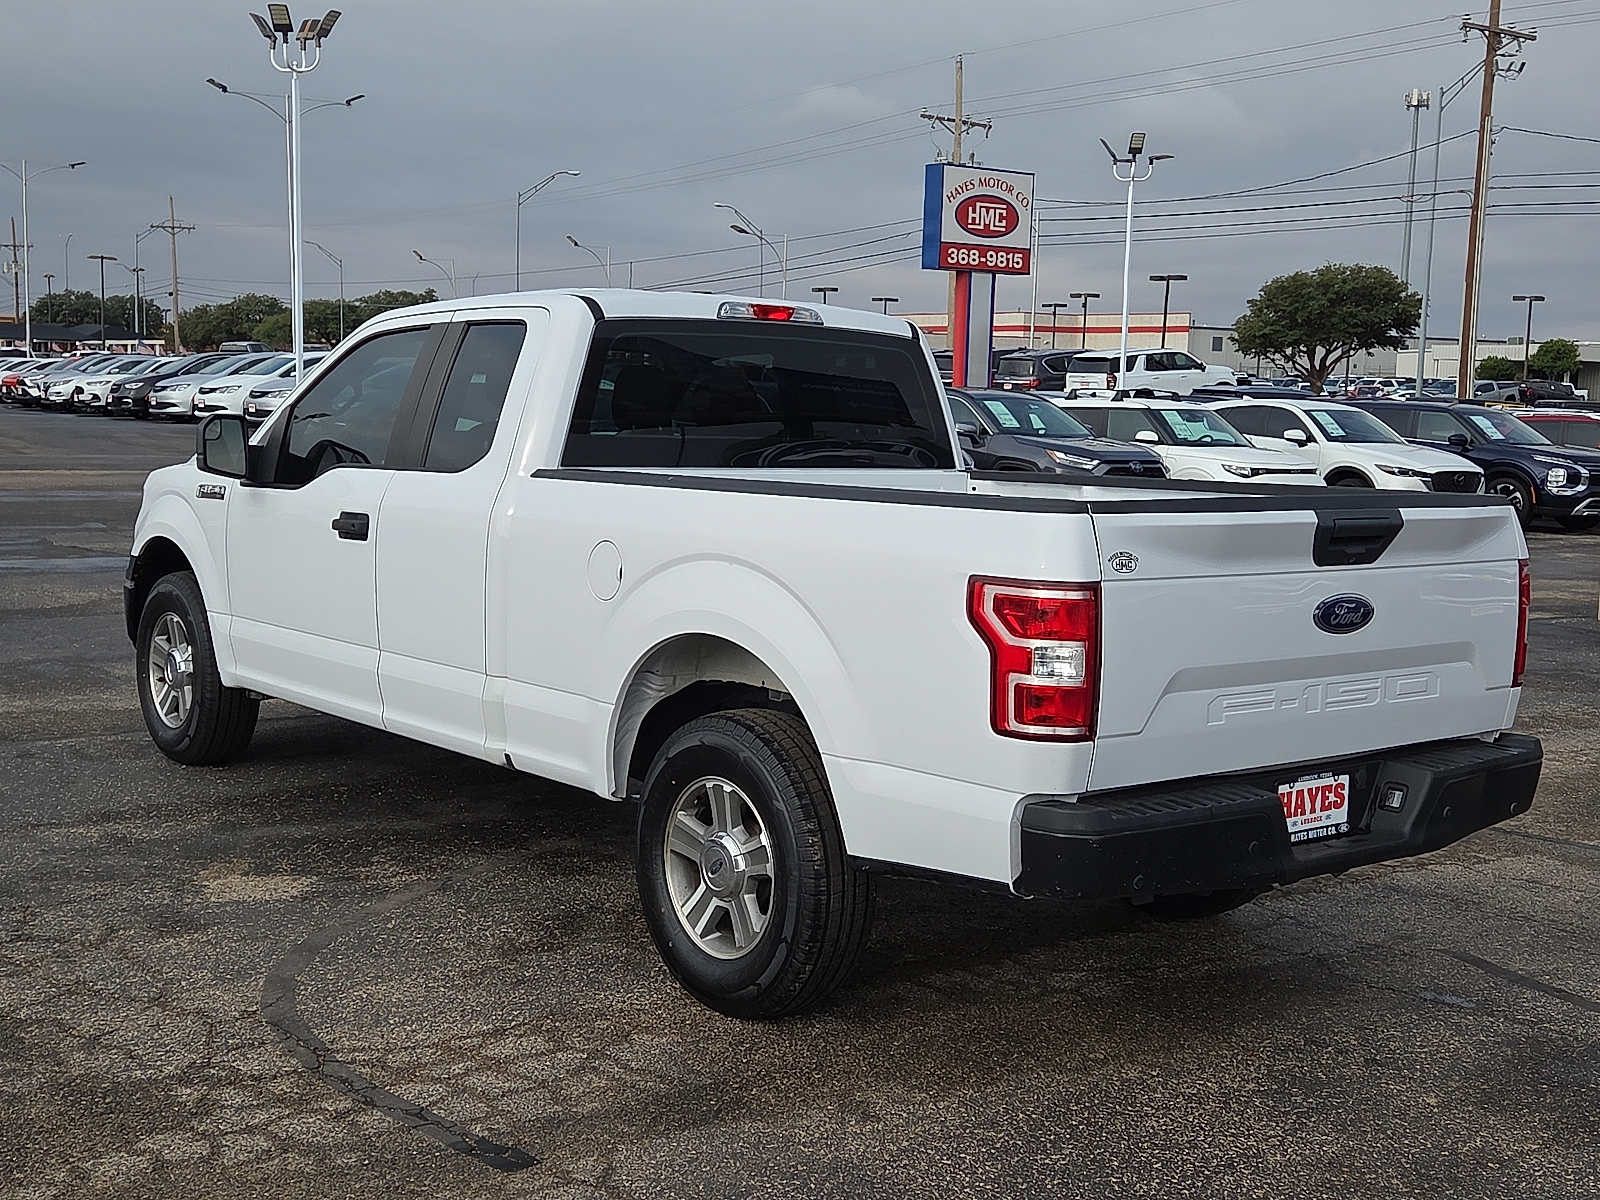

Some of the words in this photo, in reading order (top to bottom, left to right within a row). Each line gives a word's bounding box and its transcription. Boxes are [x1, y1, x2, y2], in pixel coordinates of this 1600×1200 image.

[946, 178, 976, 203] HAYES
[978, 177, 1015, 196] MOTOR
[1015, 191, 1030, 211] CO.
[967, 202, 1007, 232] HMC
[947, 247, 1023, 268] 368-9815
[1330, 602, 1364, 625] Ford
[1206, 671, 1441, 726] F-150
[1279, 782, 1346, 819] HAYES
